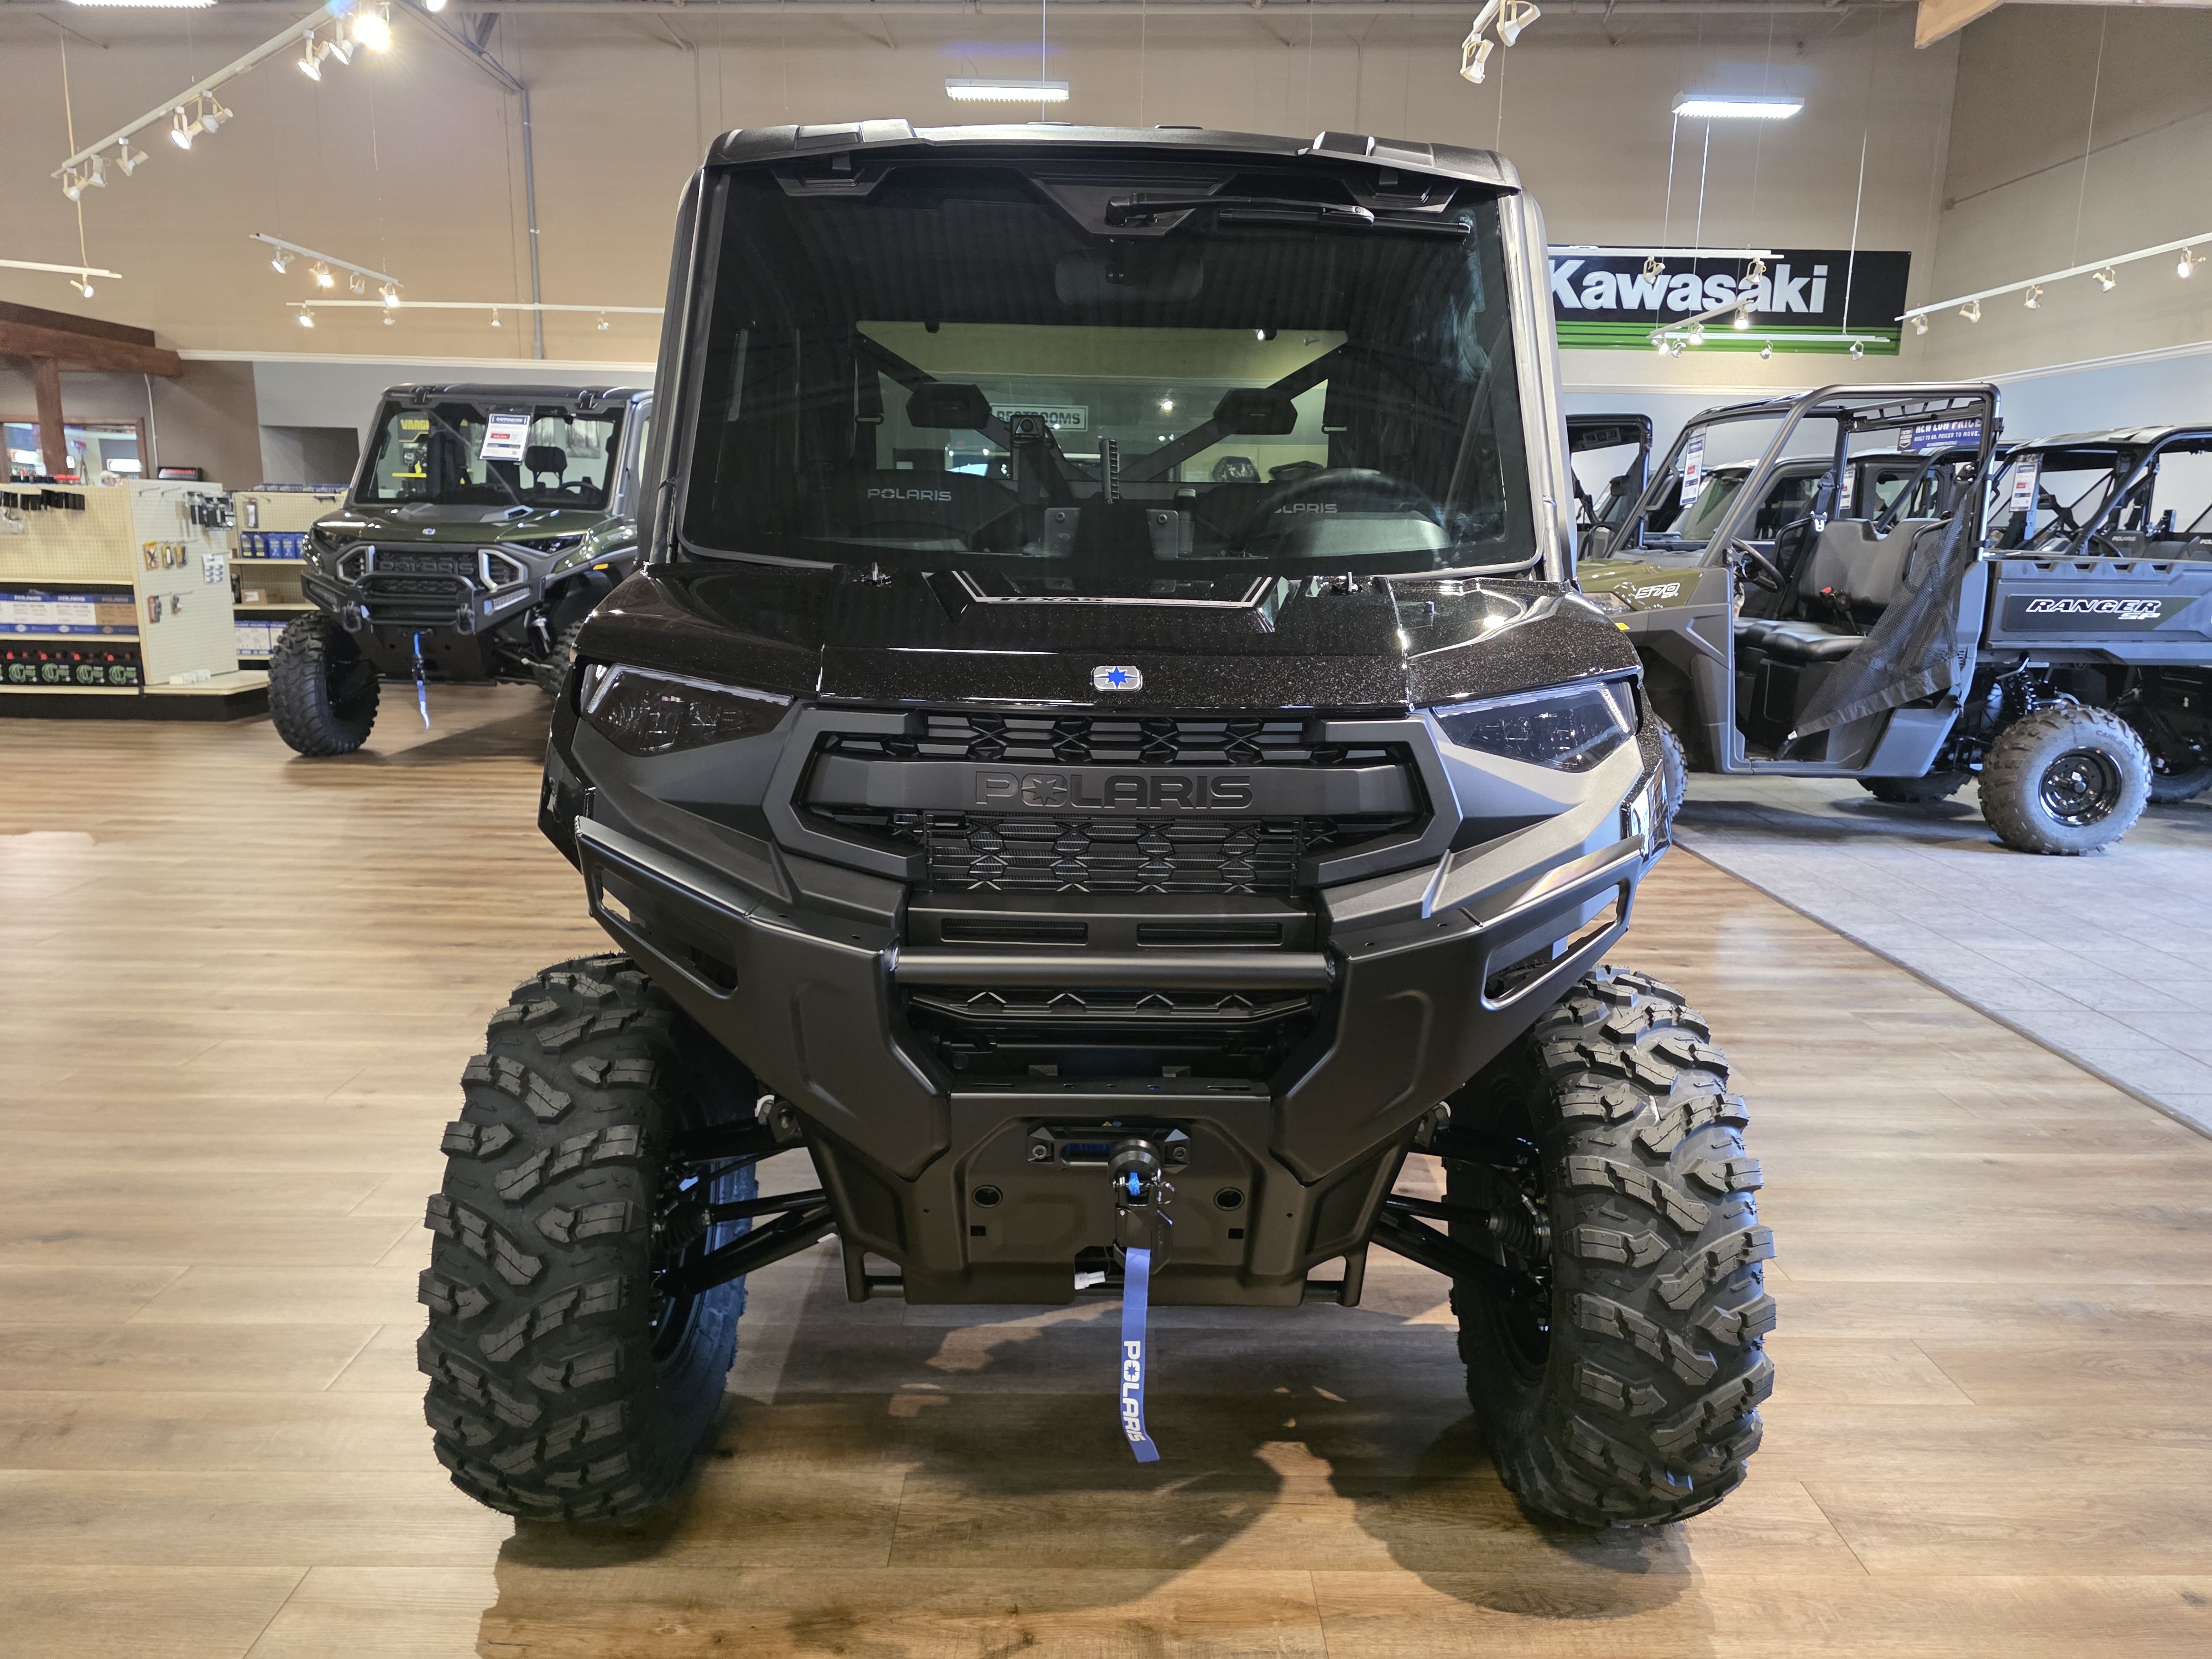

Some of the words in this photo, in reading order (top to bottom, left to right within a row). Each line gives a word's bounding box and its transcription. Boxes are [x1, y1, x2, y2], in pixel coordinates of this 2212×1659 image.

[1548, 259, 1828, 313] Kawasaki
[997, 410, 1081, 425] REOOMS
[868, 488, 952, 502] POLARIS
[1635, 582, 1681, 599] 570
[2026, 599, 2162, 613] RANGER
[975, 770, 1254, 809] POLARIS
[1121, 1340, 1146, 1442] POLARIS
